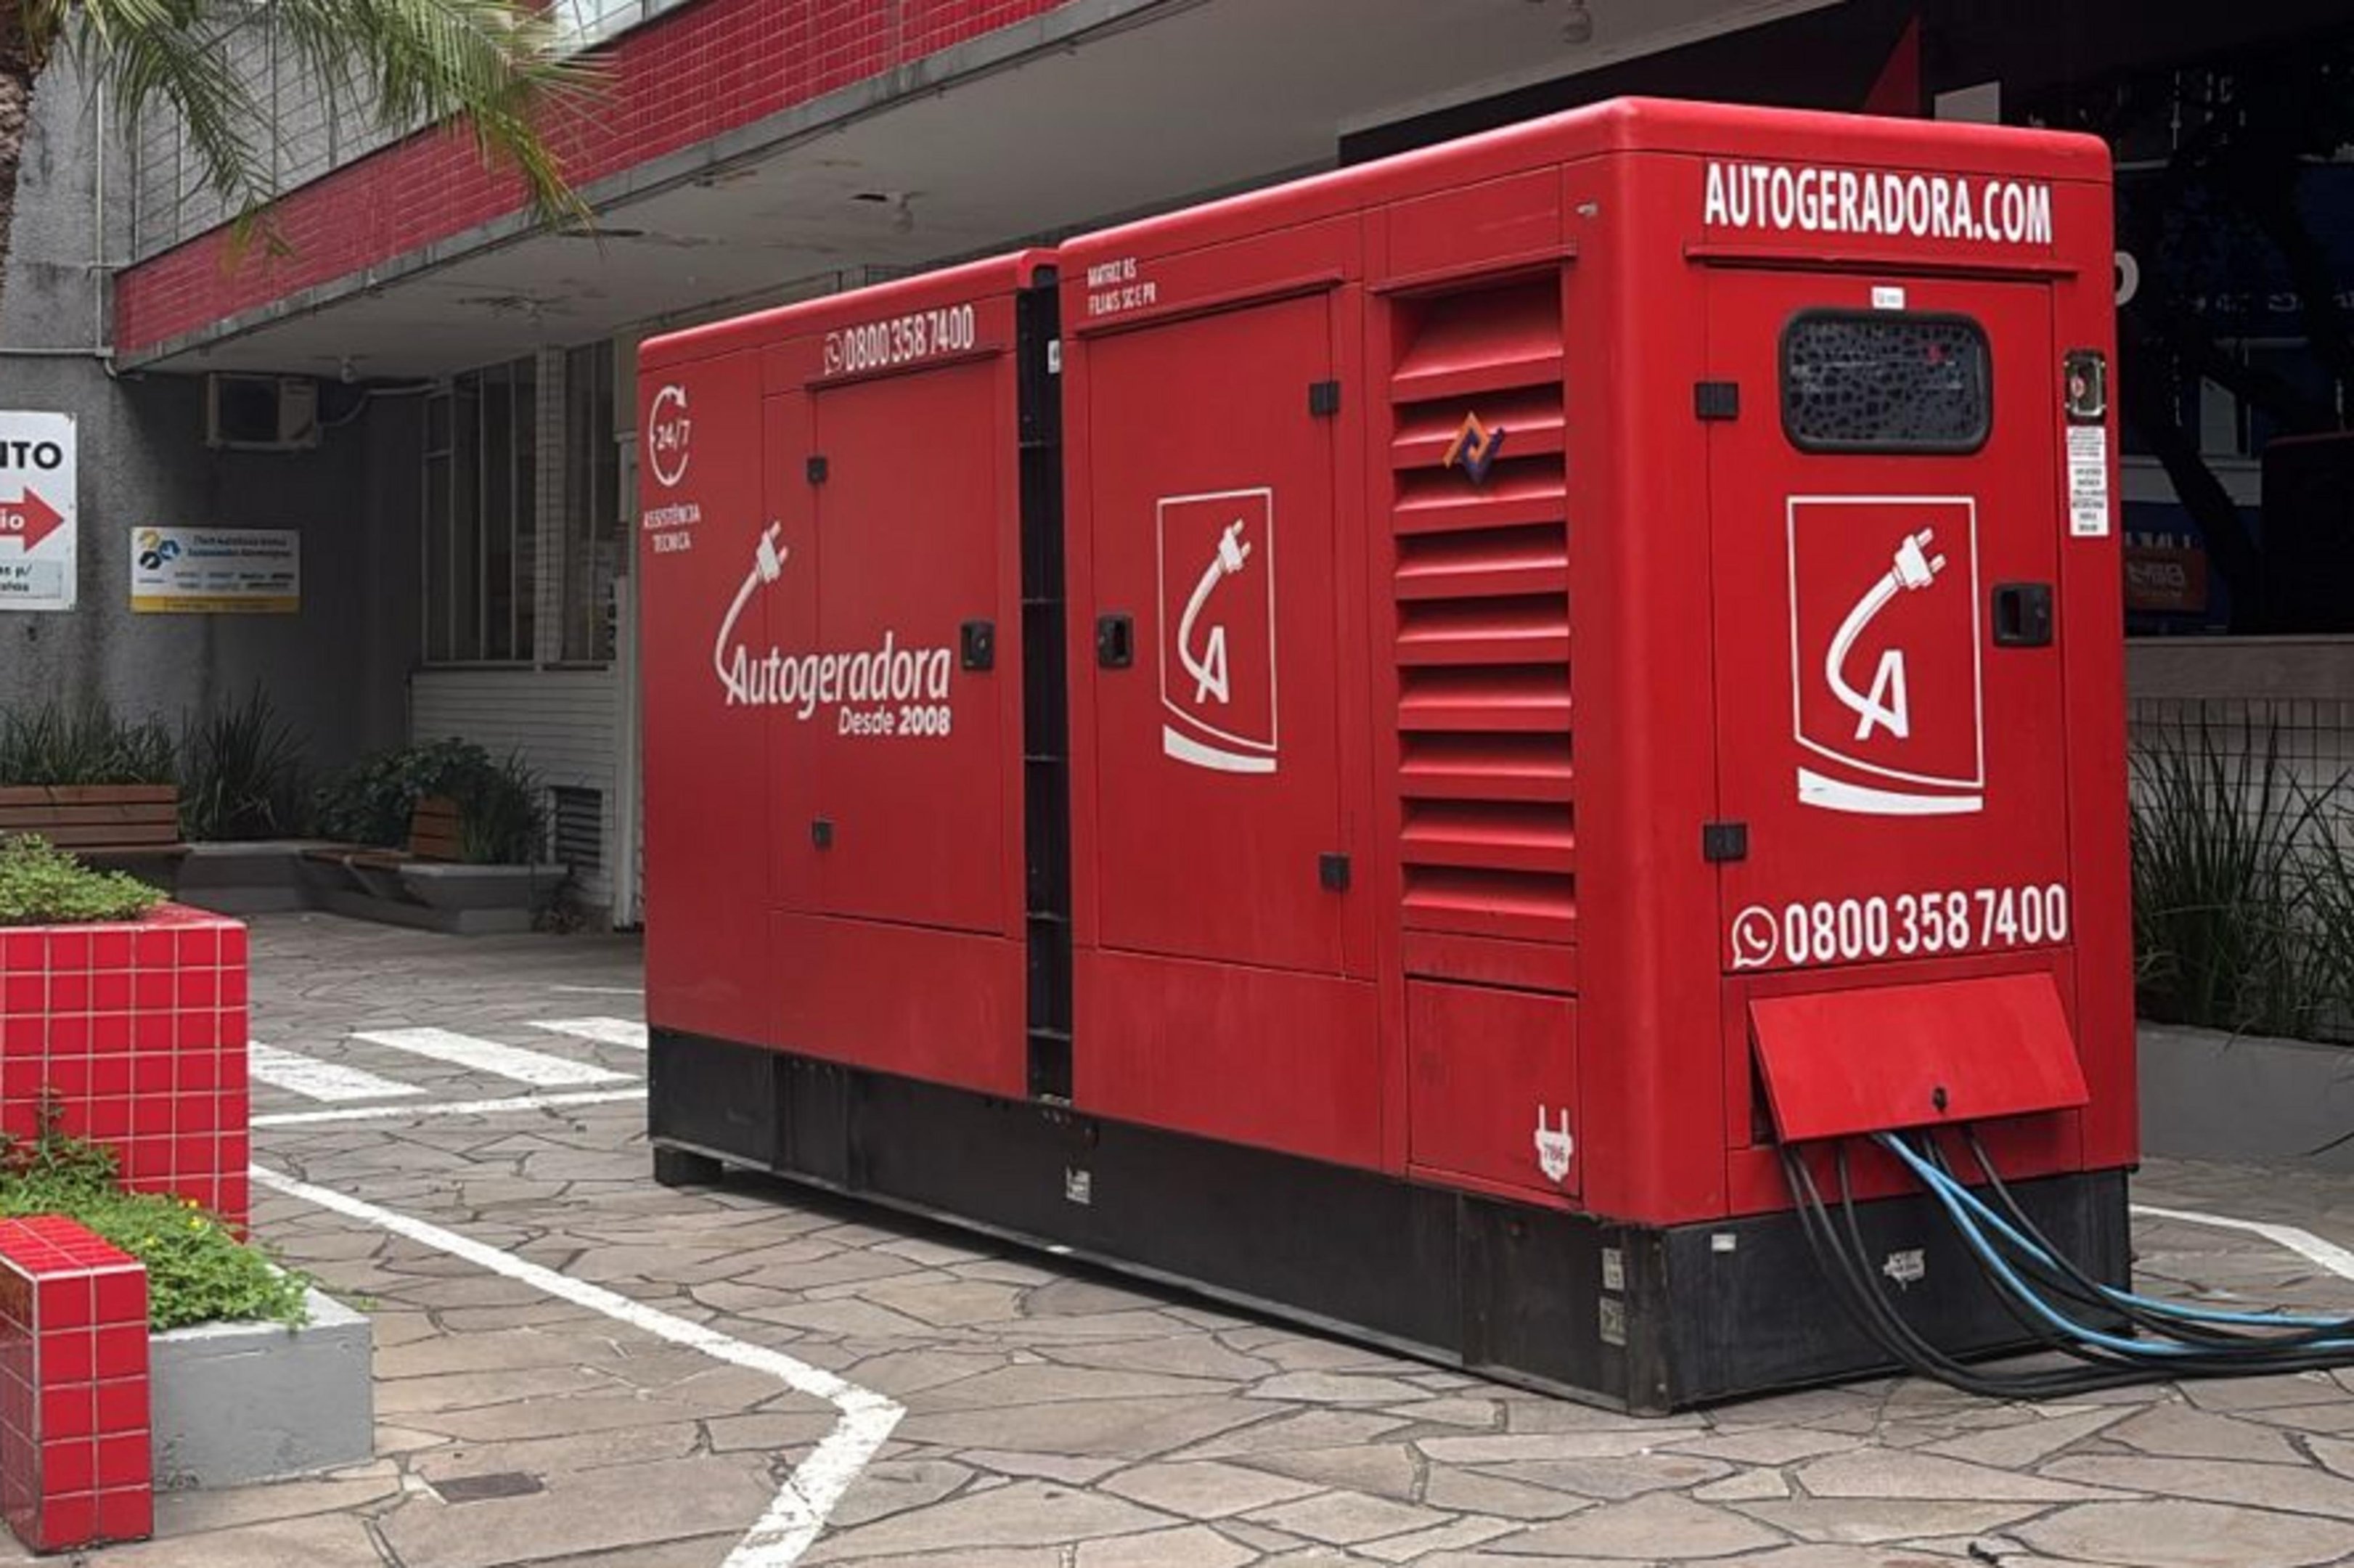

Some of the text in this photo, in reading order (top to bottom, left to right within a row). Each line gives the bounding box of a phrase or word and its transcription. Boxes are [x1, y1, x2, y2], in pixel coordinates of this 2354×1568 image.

[1705, 162, 2053, 243] AUTOGERADORA.COM
[845, 303, 975, 372] 0800 358 7400
[656, 418, 691, 452] 24/7
[727, 629, 952, 719] Autogeradora
[838, 706, 952, 736] Desde 2008
[1784, 883, 2068, 964] 0800 358 7400
